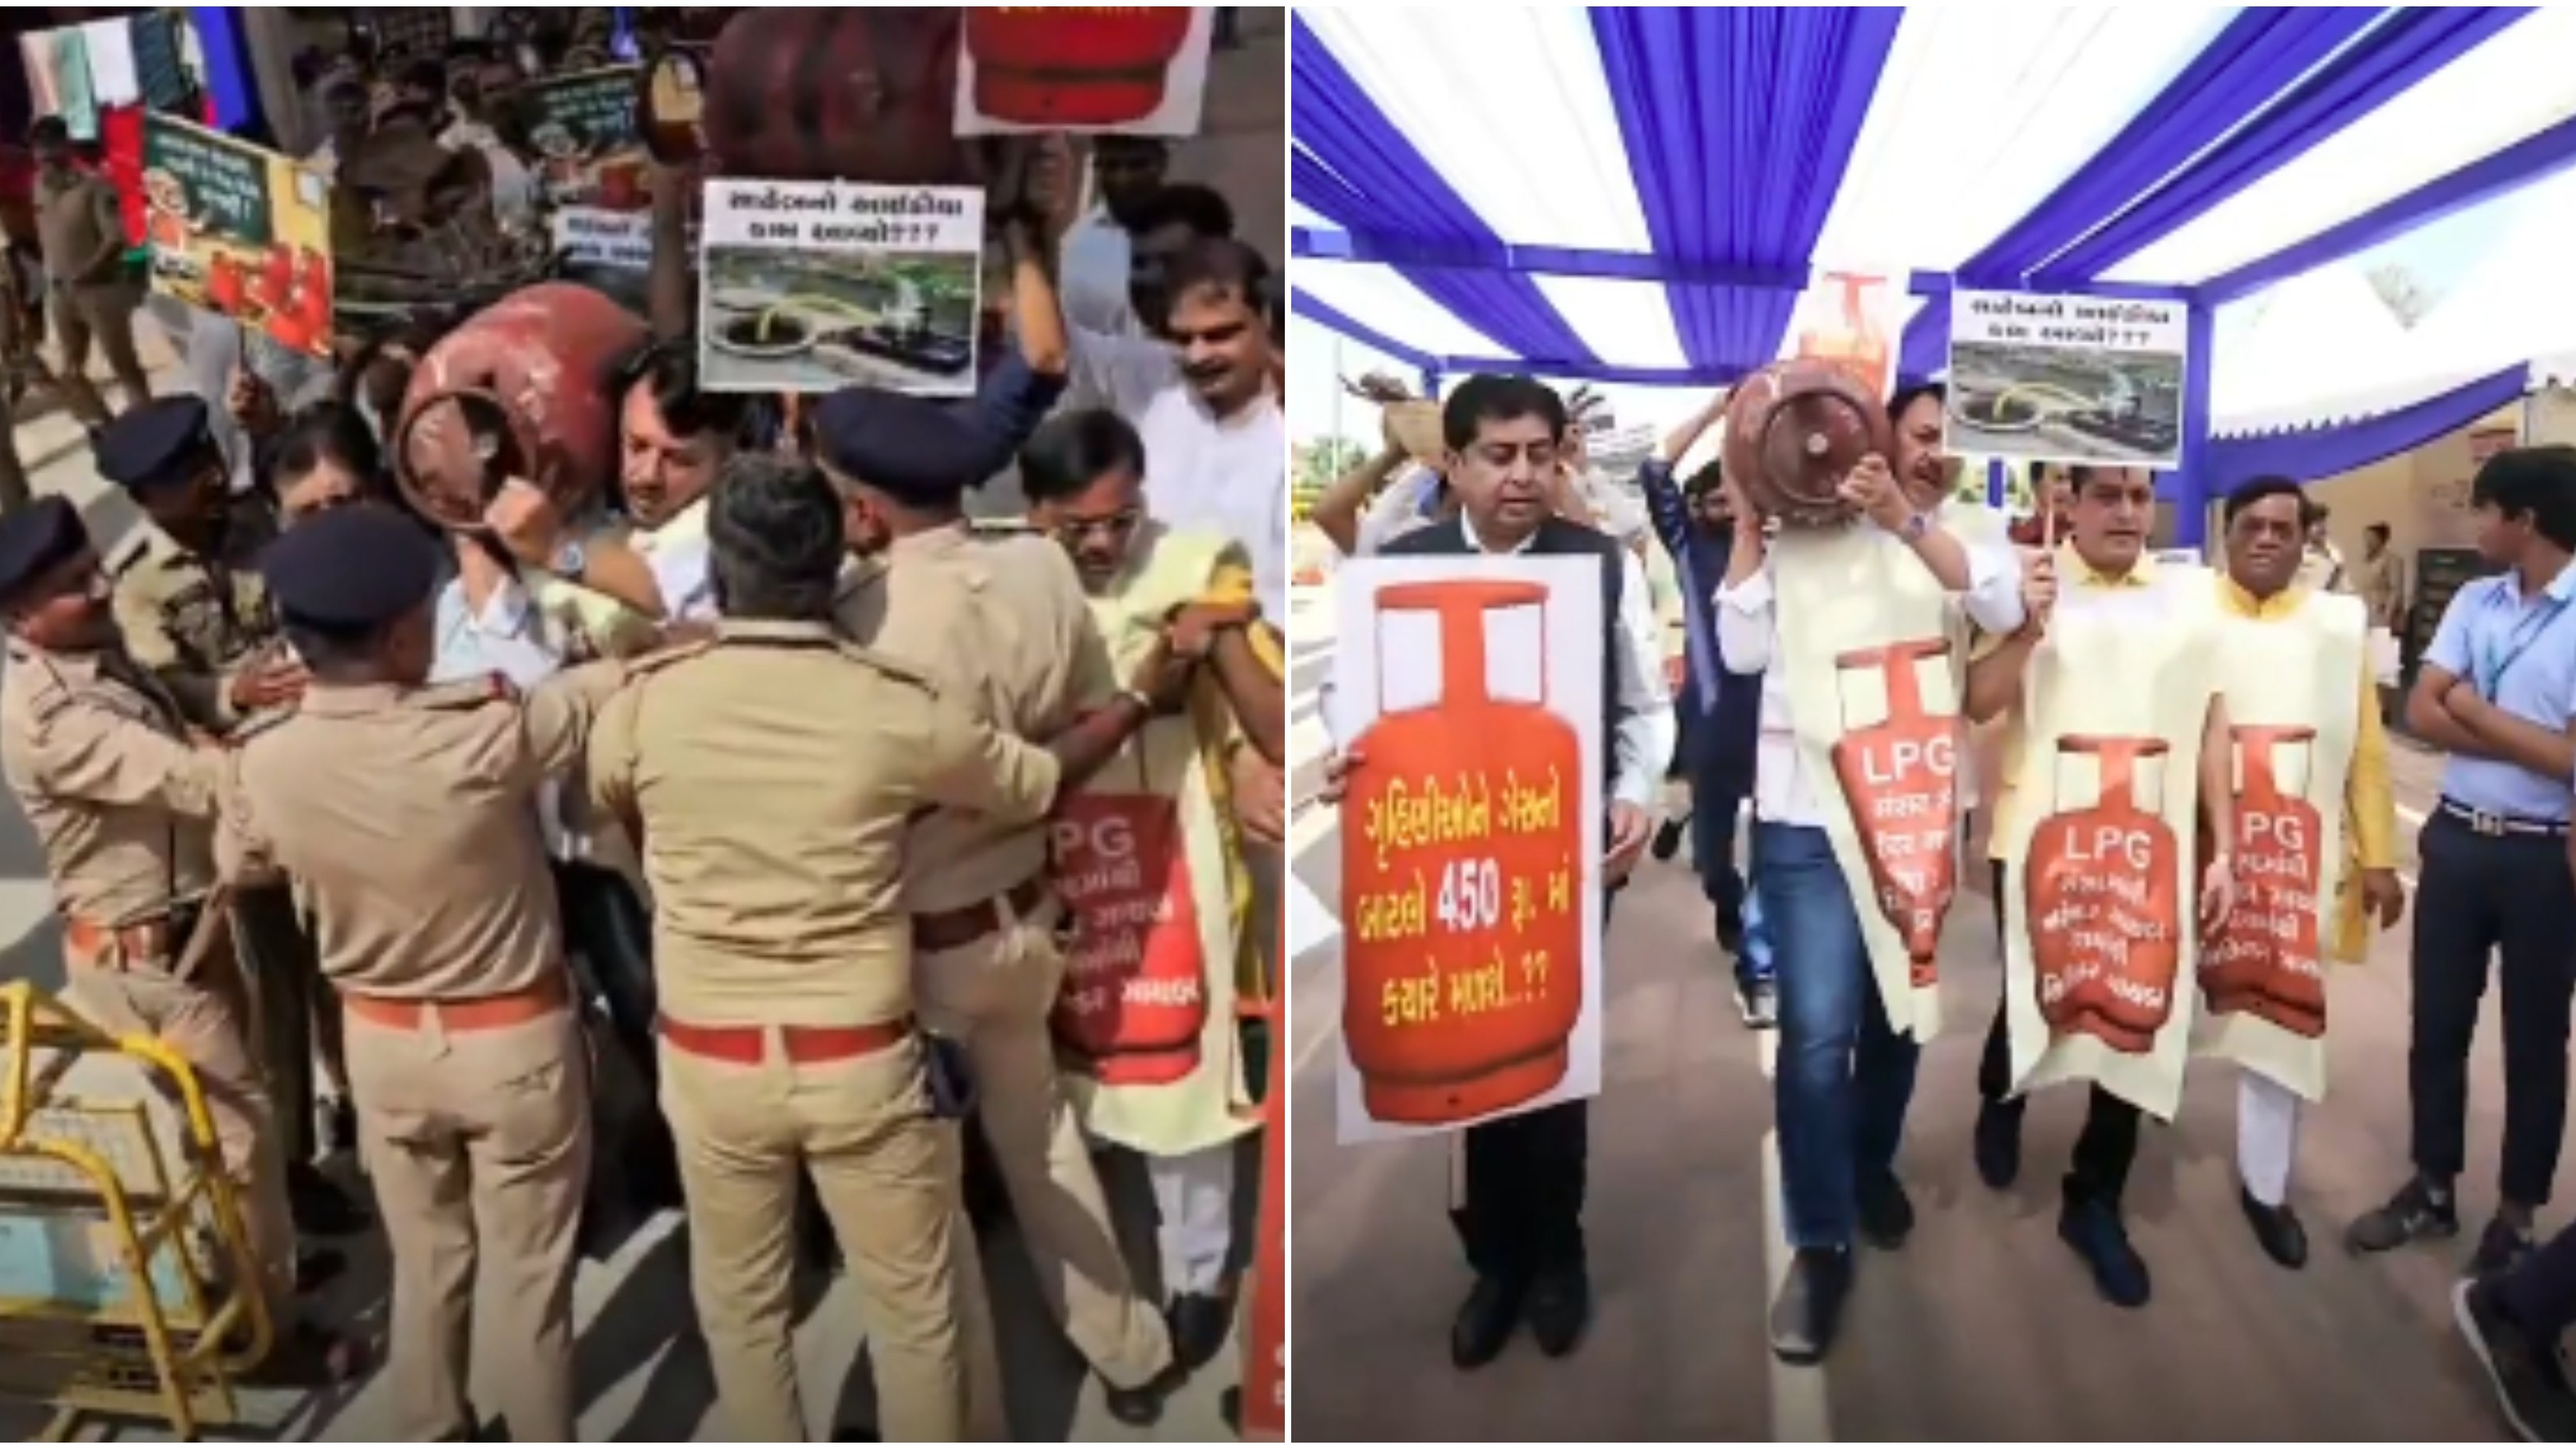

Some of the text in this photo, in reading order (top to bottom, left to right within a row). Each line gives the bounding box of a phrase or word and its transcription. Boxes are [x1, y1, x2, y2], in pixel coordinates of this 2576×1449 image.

[1862, 732, 1954, 786] LPG
[1052, 815, 1136, 865] PG
[2065, 824, 2152, 870] LPG
[2242, 811, 2305, 851] PG
[1437, 856, 1500, 934] 450
